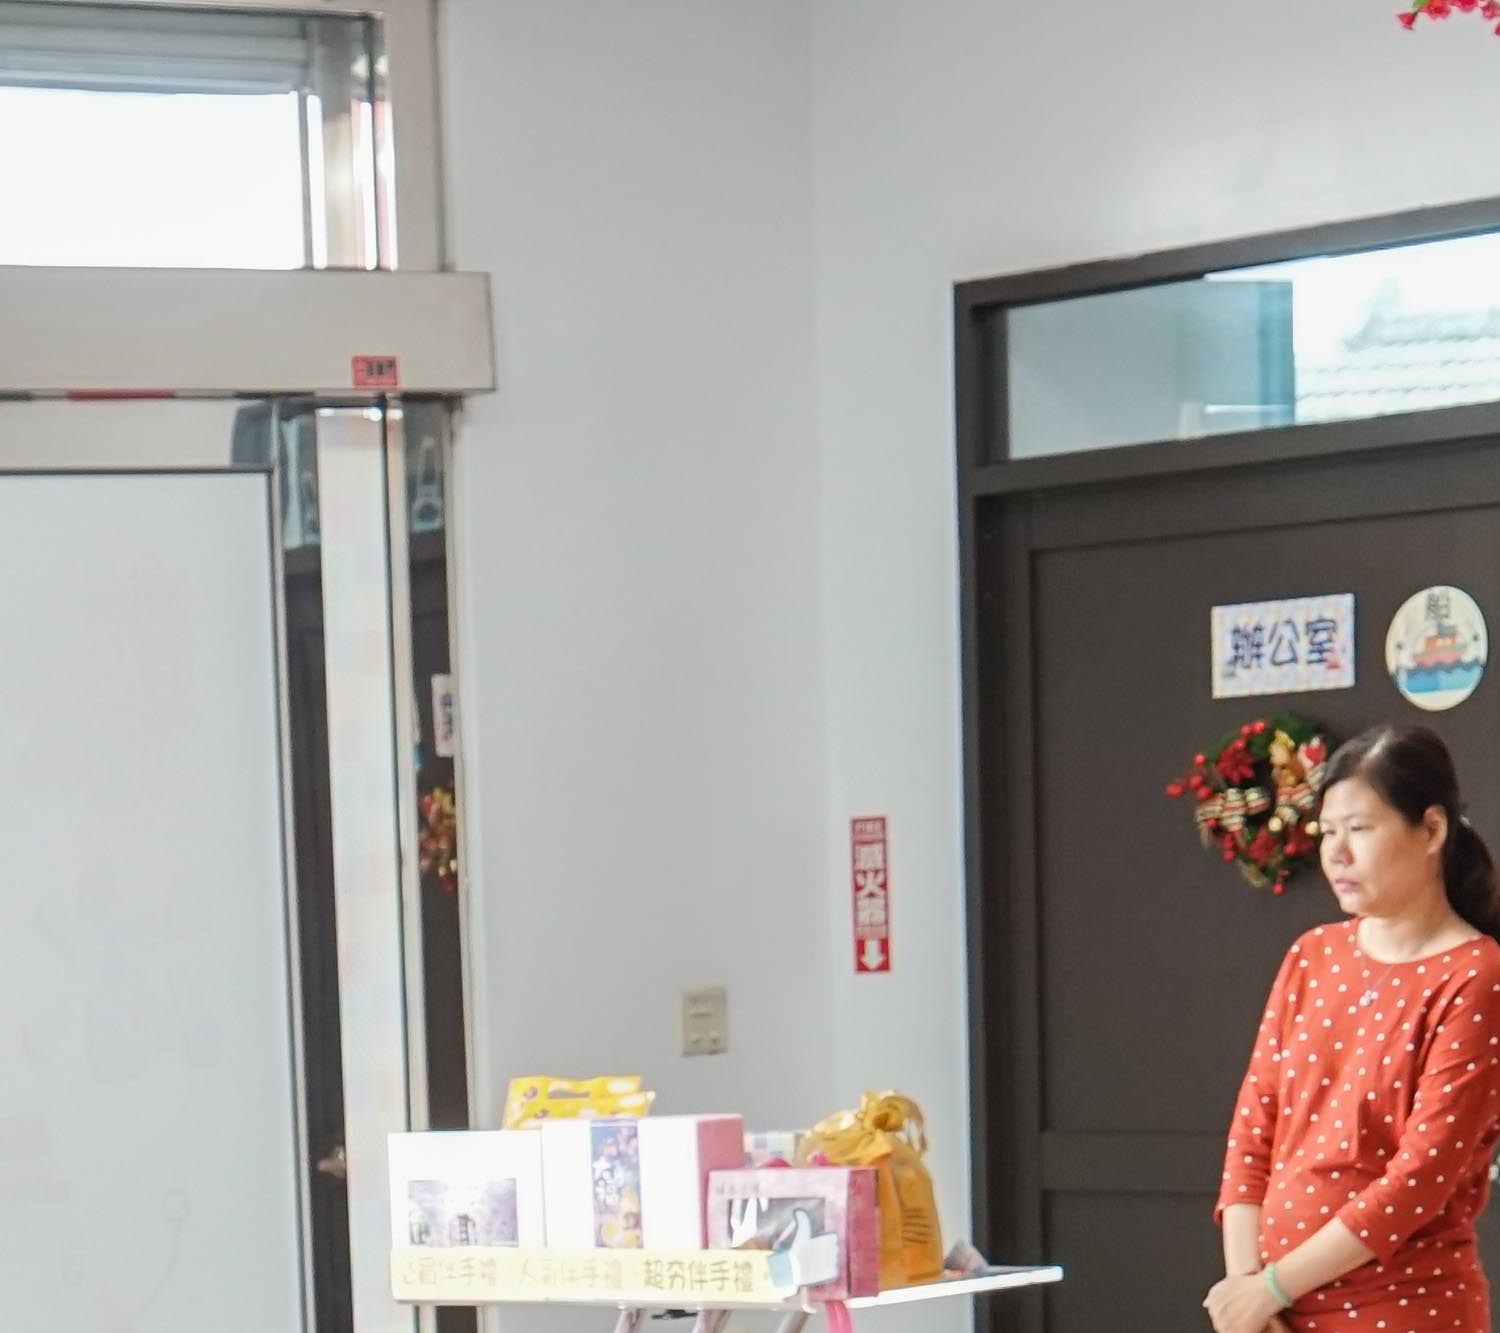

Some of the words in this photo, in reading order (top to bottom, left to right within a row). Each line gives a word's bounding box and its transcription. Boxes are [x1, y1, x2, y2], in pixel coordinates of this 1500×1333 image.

[1230, 614, 1338, 670] 辦公室
[643, 1258, 754, 1293] 超夯伴手禮
